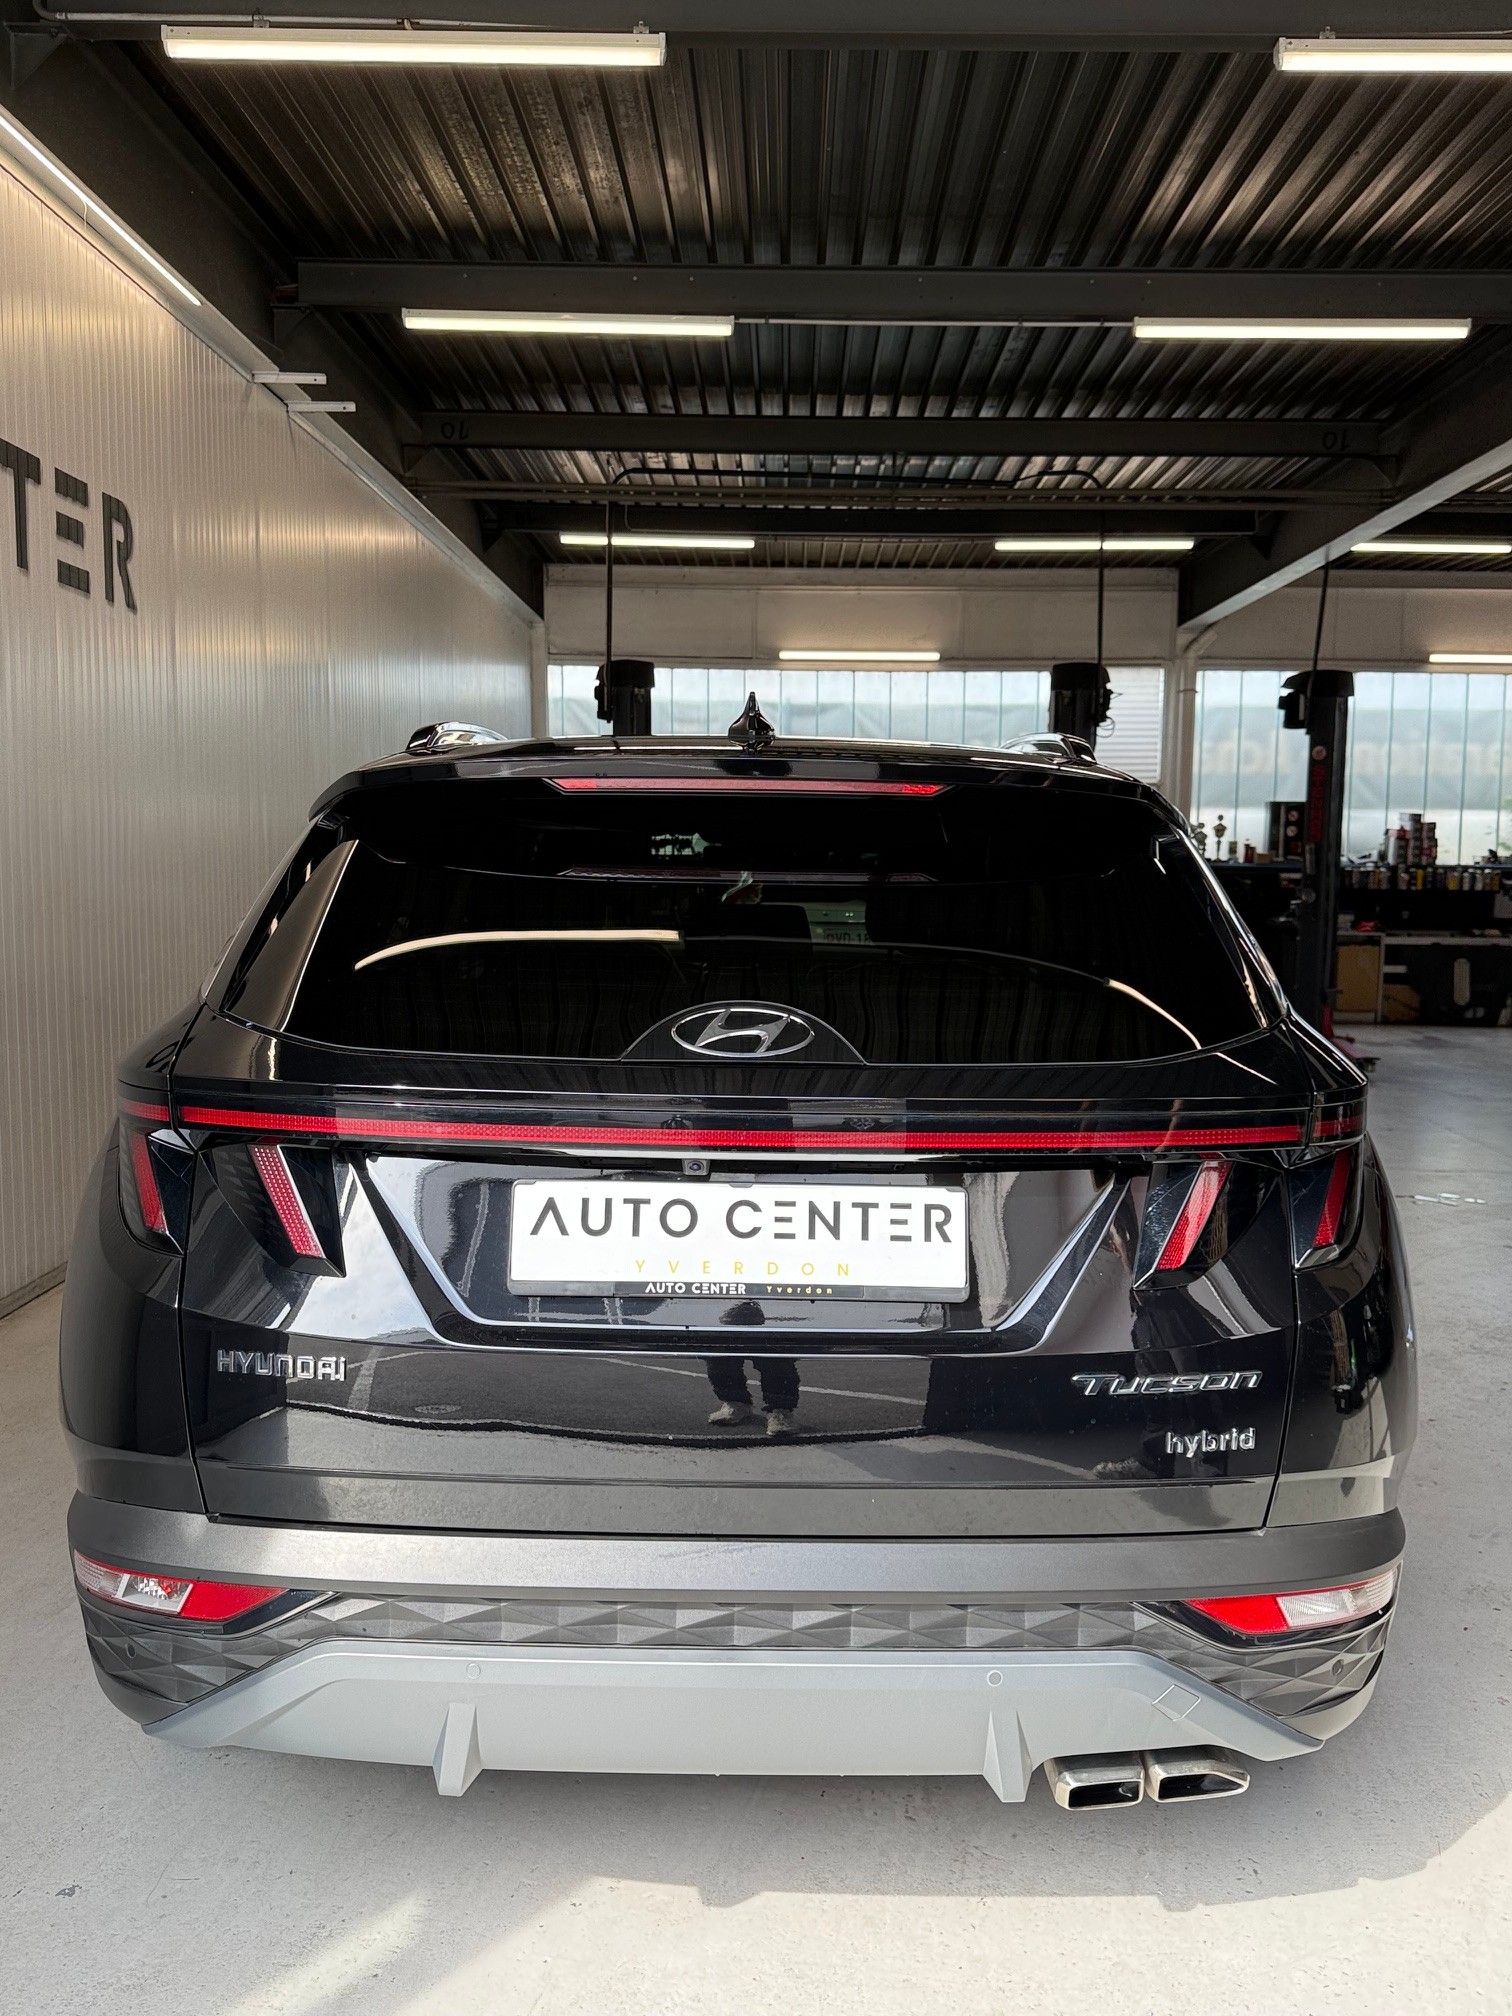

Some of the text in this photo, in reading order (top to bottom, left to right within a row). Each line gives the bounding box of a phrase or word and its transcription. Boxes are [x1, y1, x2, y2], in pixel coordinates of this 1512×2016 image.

[0, 437, 138, 613] TER
[529, 1196, 952, 1244] AUTO CENTER
[635, 1259, 851, 1278] YVERDON
[645, 1282, 833, 1295] AUTO CENTER Yverdon
[217, 1349, 346, 1382] HYUNDAI
[1165, 1427, 1257, 1459] hybrid
